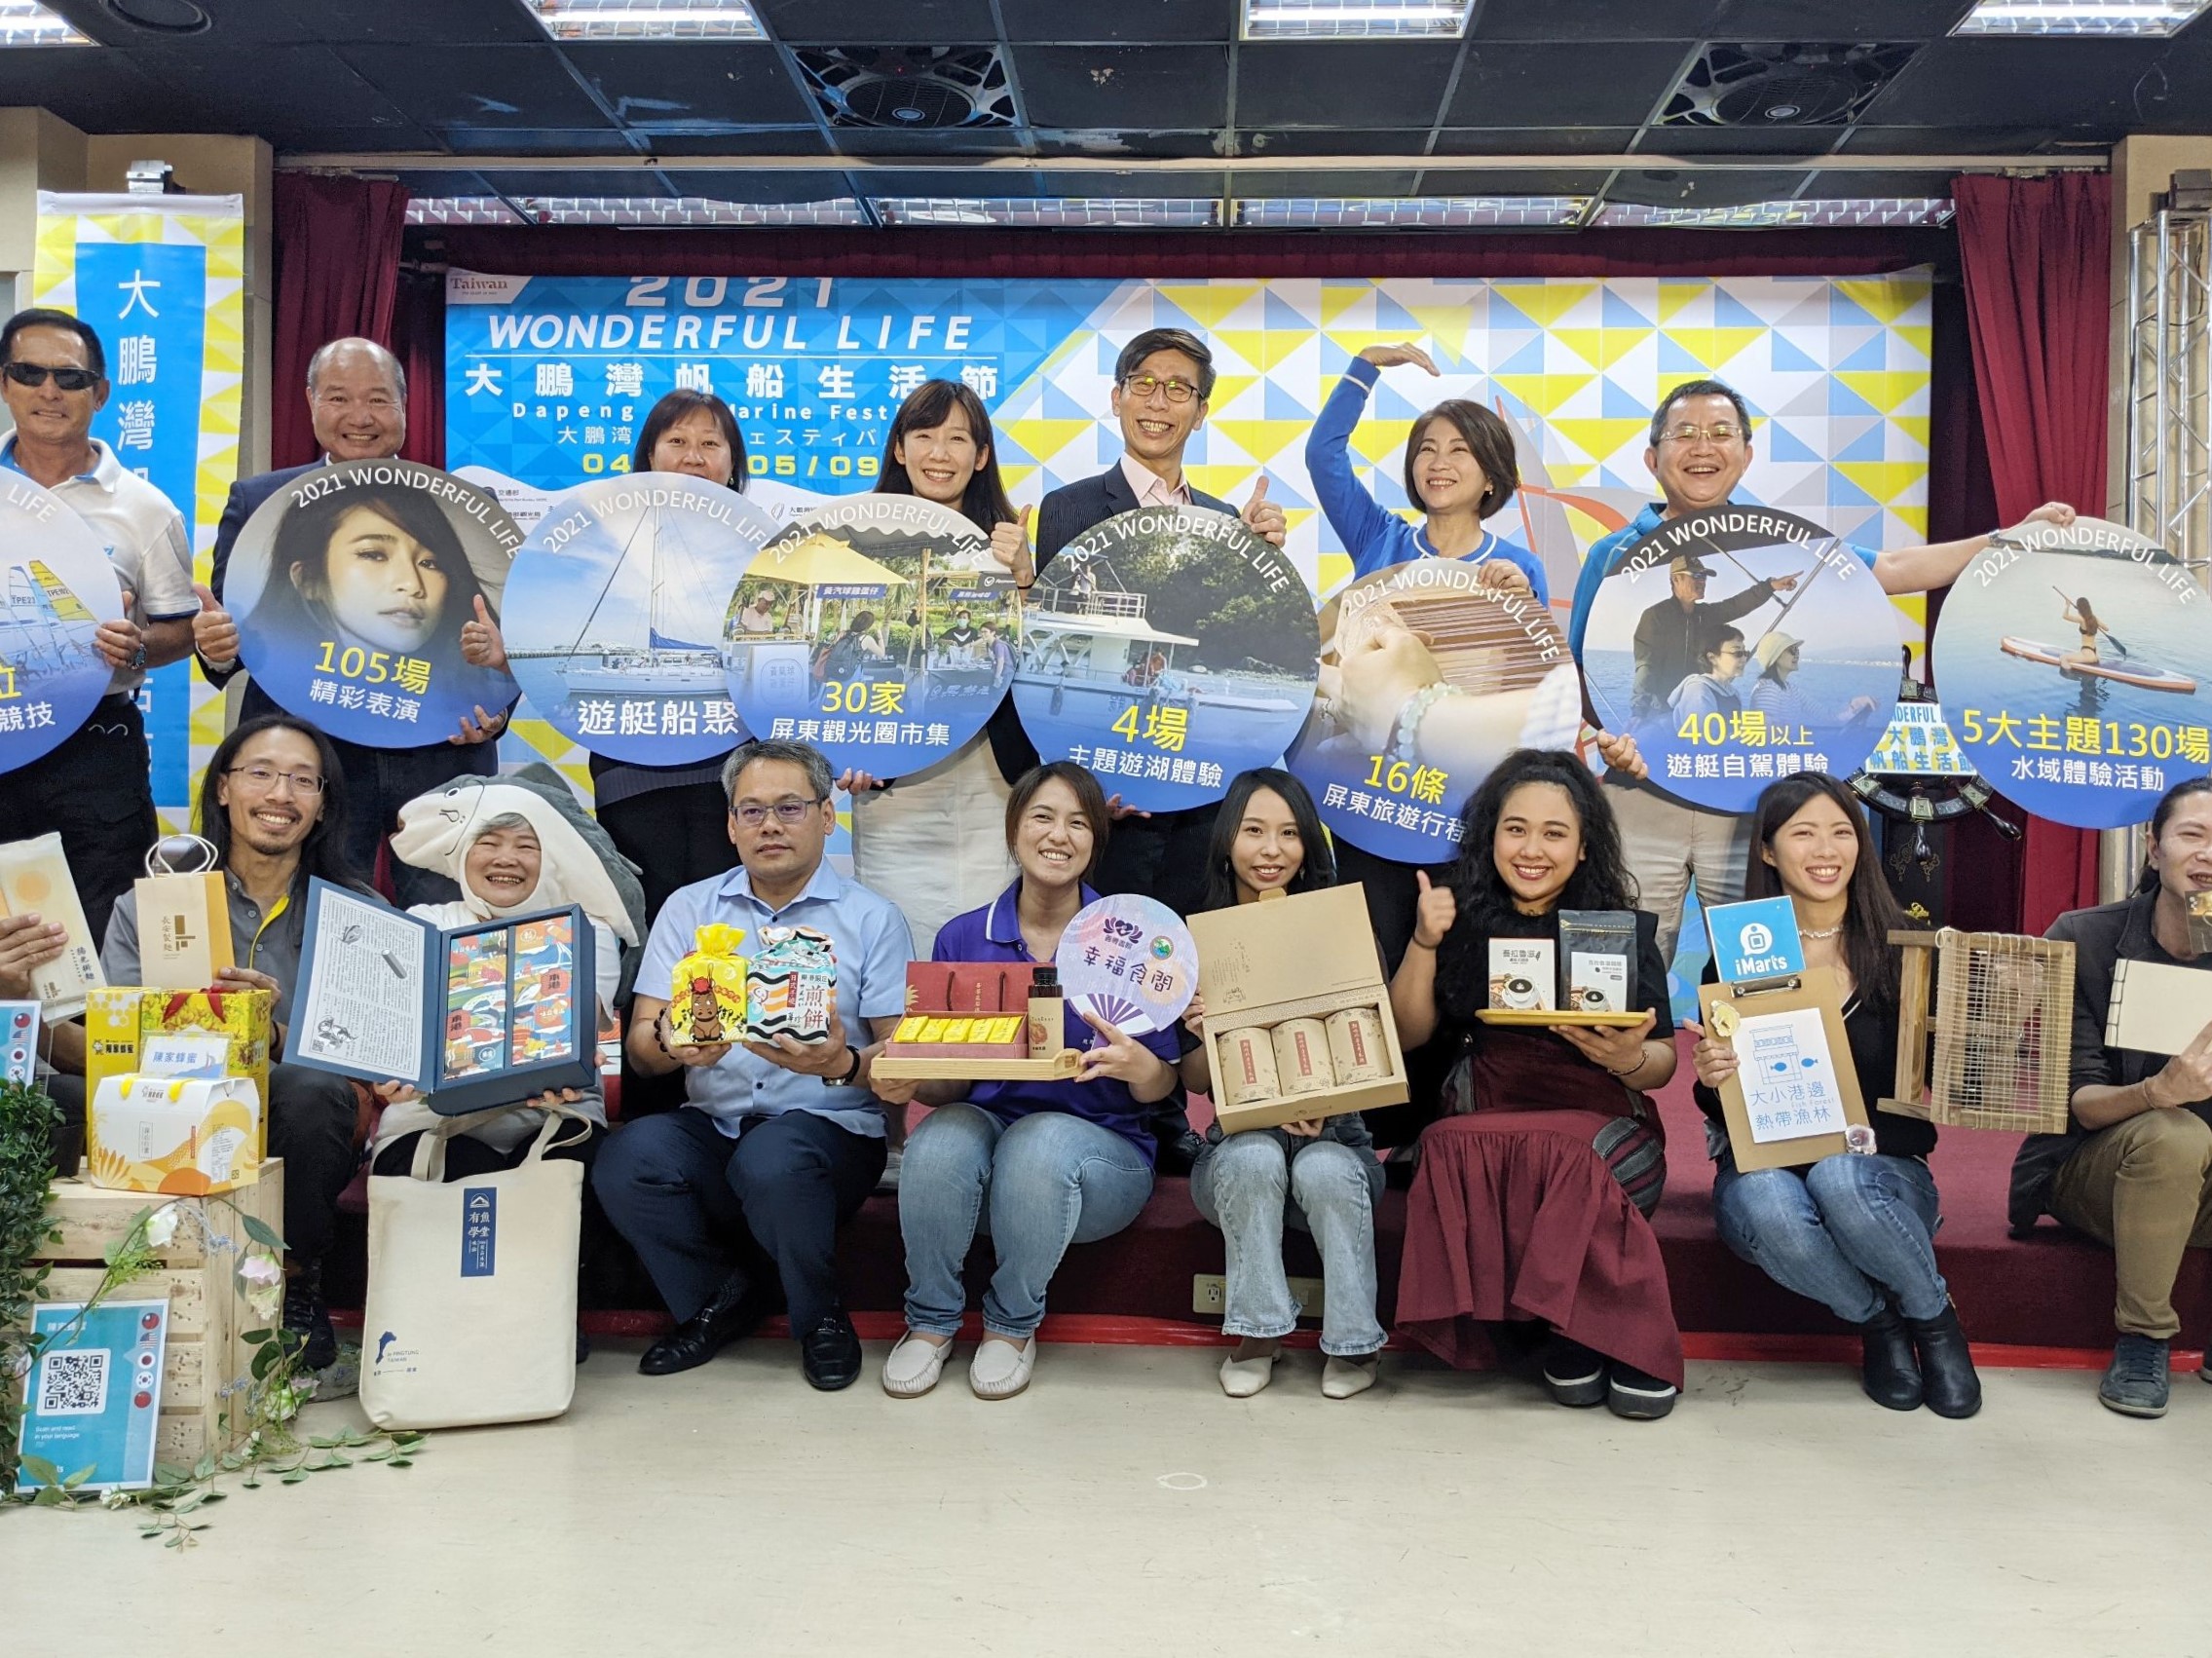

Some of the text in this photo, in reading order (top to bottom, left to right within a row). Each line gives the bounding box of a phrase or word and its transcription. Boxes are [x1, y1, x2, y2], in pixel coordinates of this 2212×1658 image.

[450, 277, 507, 290] Taiwan
[625, 276, 835, 308] 2021
[489, 314, 973, 350] WONDERFUL LIFE
[117, 269, 161, 486] 大鵬灣
[465, 361, 998, 400] 大鵬灣帆船生活節
[512, 401, 634, 422] Dapeng
[557, 426, 890, 448] 大鵬湾 ェスティバ
[582, 453, 880, 477] 04 05/09
[7, 483, 56, 523] LIFE
[291, 468, 522, 559] 2021 WONDERFUL LIFE
[544, 490, 770, 554] 2021 WONDERFUL LIFE
[769, 503, 990, 566] 2021 WONDERFUL LIFE
[1621, 514, 1856, 584] 2021 WONDERFUL LIFE
[1063, 515, 1291, 594] 2021 WONDERFUL LIFE
[1972, 525, 2196, 606] 2021 WONDERFUL LIFE
[1343, 579, 1389, 615] 2021
[1525, 607, 1559, 662] LIFE
[314, 642, 432, 695] 105場
[310, 678, 421, 723] 精彩表演
[578, 700, 738, 736] 遊艇船聚
[822, 681, 906, 716] 30家
[770, 718, 950, 748] 屏東觀光圈市集
[1110, 704, 1188, 752] 4場
[1887, 726, 1949, 747] 大鵬灣
[1962, 709, 2211, 765] 5大主題130場
[1069, 744, 1223, 789] 主題遊湖體驗
[1364, 754, 1448, 804] 16條
[1667, 751, 1828, 779] 遊艇自駕體驗
[2010, 754, 2164, 792] 水域體驗活動
[1322, 781, 1464, 844] 屏東旅遊行程
[1735, 955, 1788, 975] iMarts
[805, 985, 825, 1029] 煎餅
[152, 1051, 198, 1064] 陳家蜂蜜
[1749, 1081, 1825, 1106] 大小港邊
[1755, 1106, 1831, 1130] 熱帶漁林
